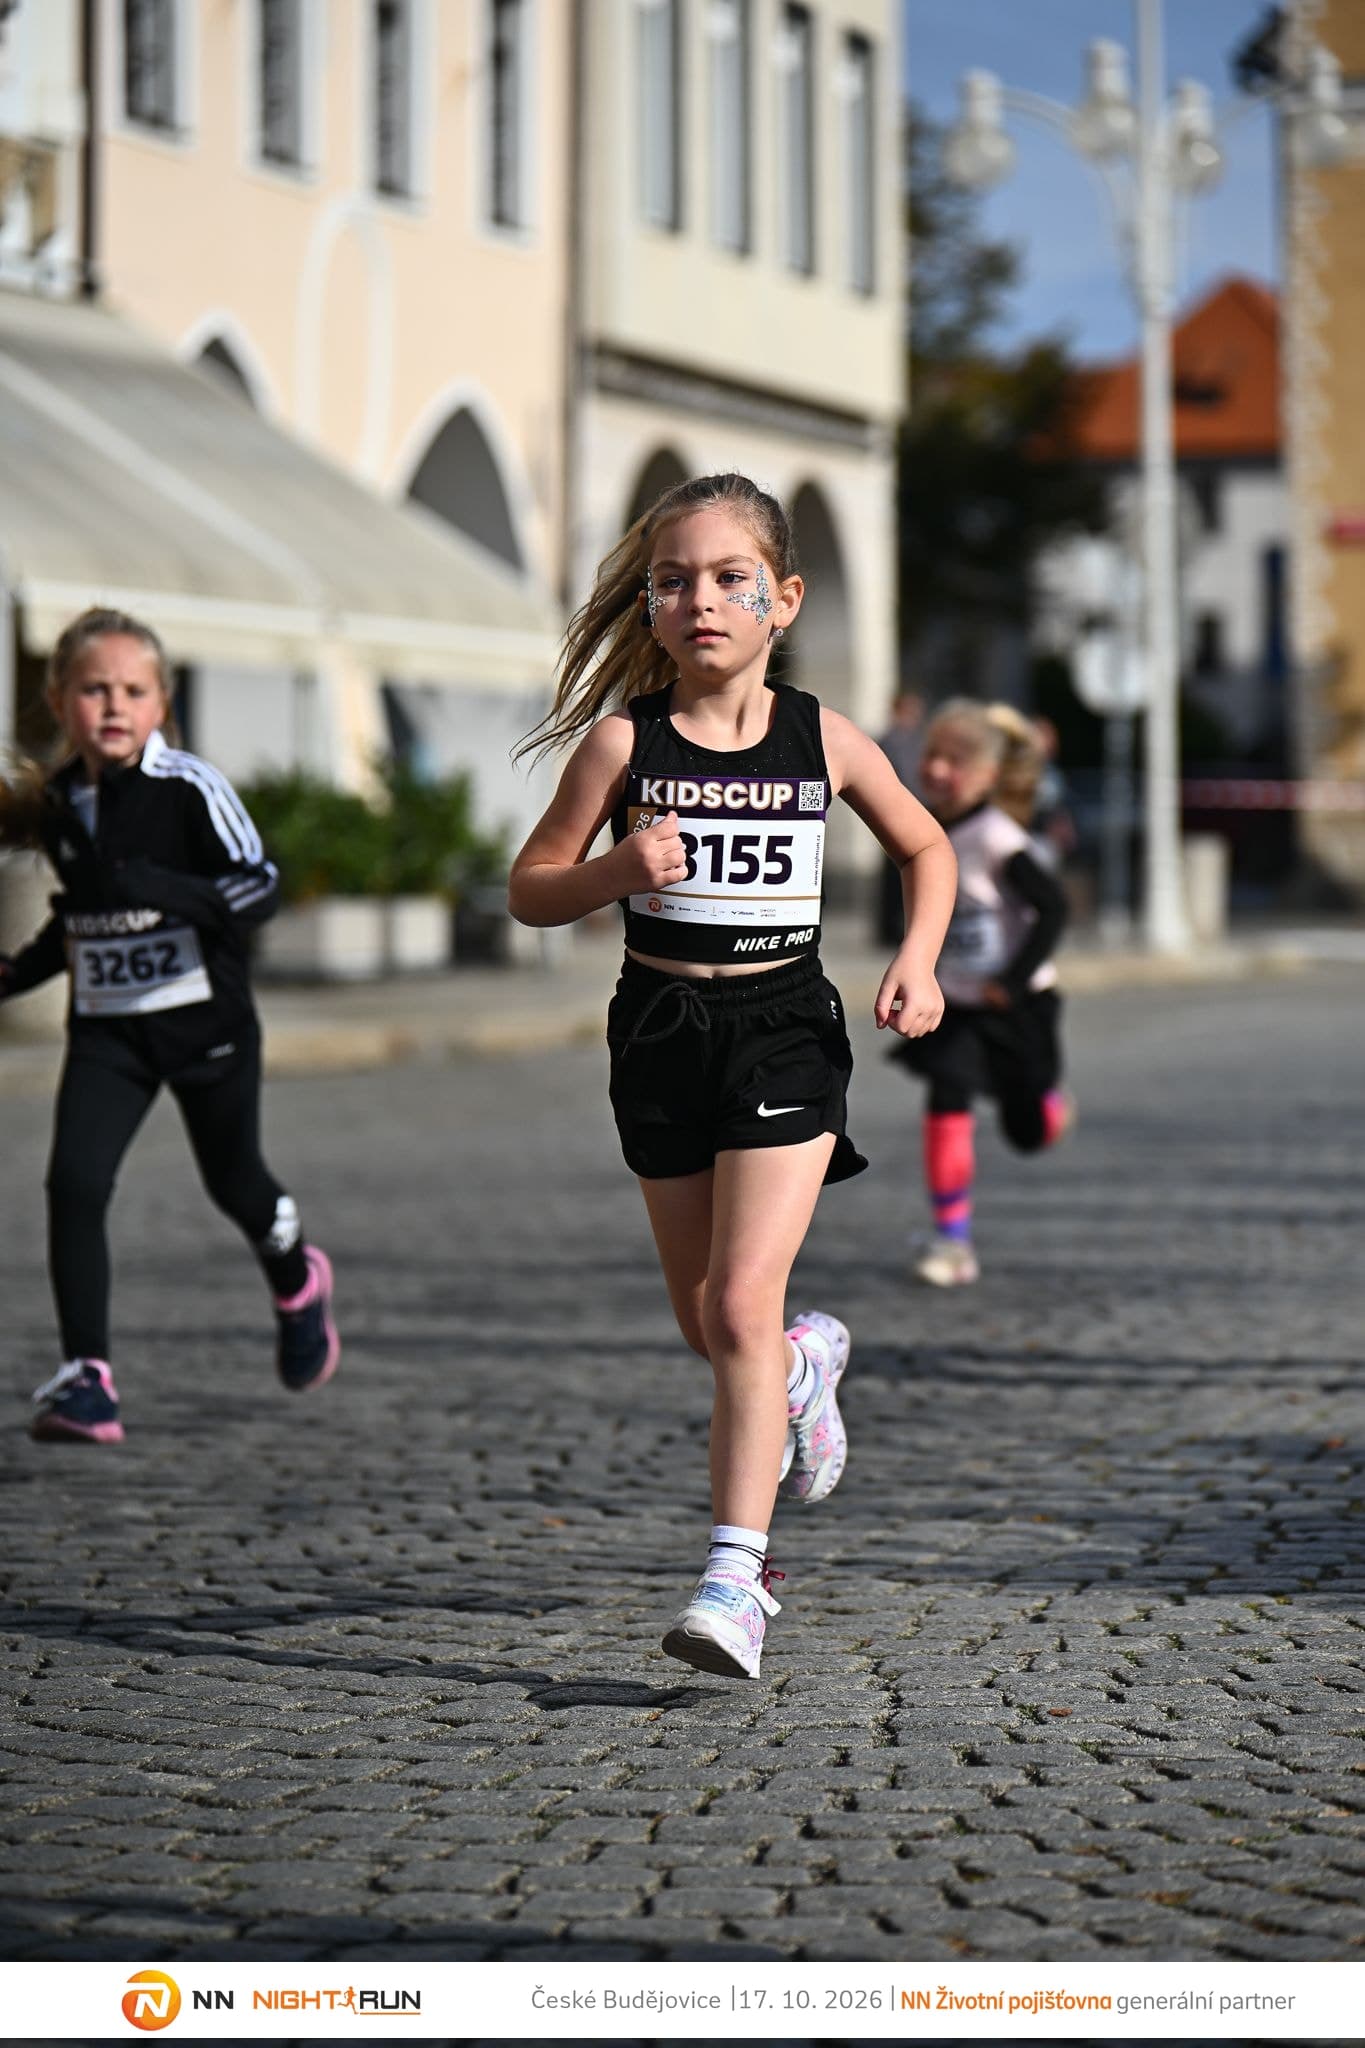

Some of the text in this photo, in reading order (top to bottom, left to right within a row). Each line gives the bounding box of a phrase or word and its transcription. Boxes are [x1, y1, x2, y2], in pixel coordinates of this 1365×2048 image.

[640, 778, 793, 811] KIDSCUP
[733, 928, 814, 952] NIKE PRO
[84, 941, 183, 987] 3262
